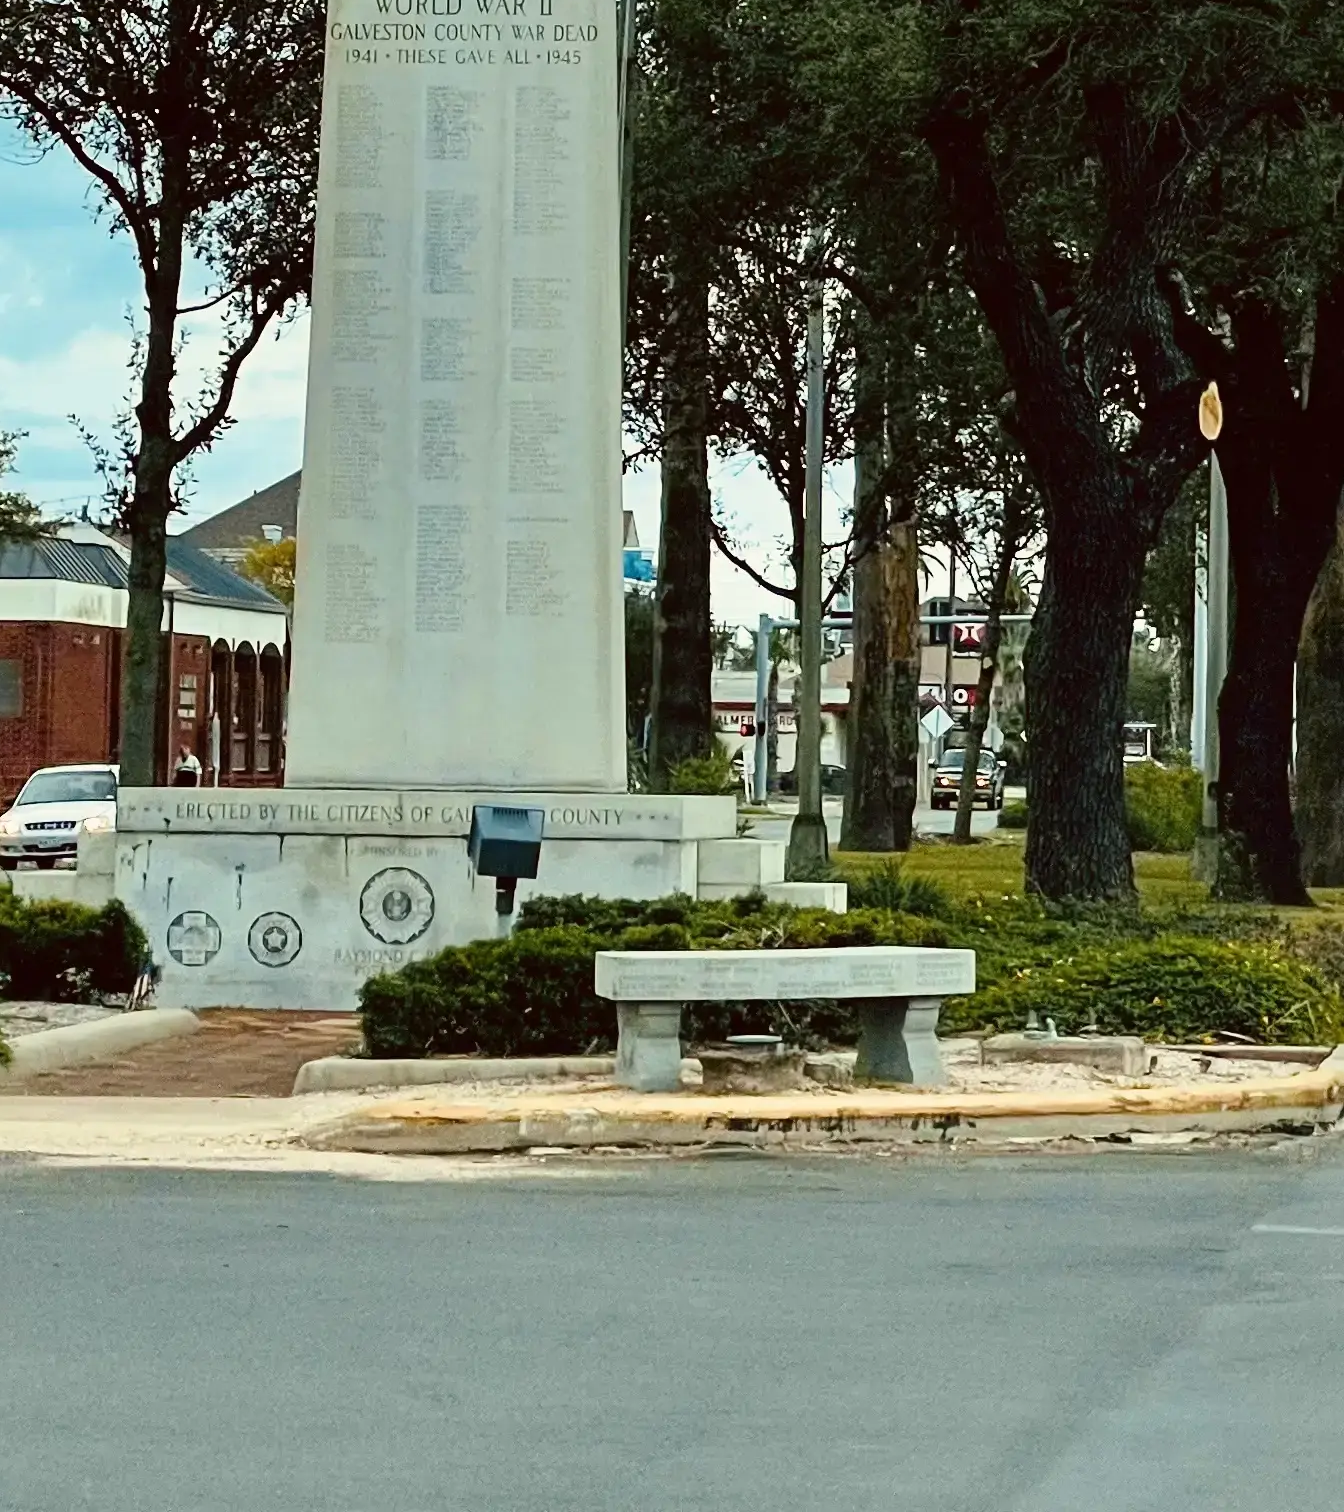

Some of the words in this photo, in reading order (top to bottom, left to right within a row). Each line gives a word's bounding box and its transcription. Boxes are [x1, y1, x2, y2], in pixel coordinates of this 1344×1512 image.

[330, 22, 426, 42] GALVESTON
[434, 23, 505, 42] COUNTY
[511, 24, 546, 42] WAR
[553, 24, 599, 43] DEAD
[344, 49, 379, 64] 1941
[396, 49, 447, 65] THESE
[455, 50, 497, 65] GAVE
[505, 50, 531, 65] ALL
[546, 50, 582, 66] 1945
[176, 802, 252, 820] ERECTED
[259, 804, 280, 821] BY
[288, 804, 318, 821] THE
[327, 805, 404, 823] CITIZENS
[411, 806, 434, 823] OF
[550, 807, 624, 826] COUNTY
